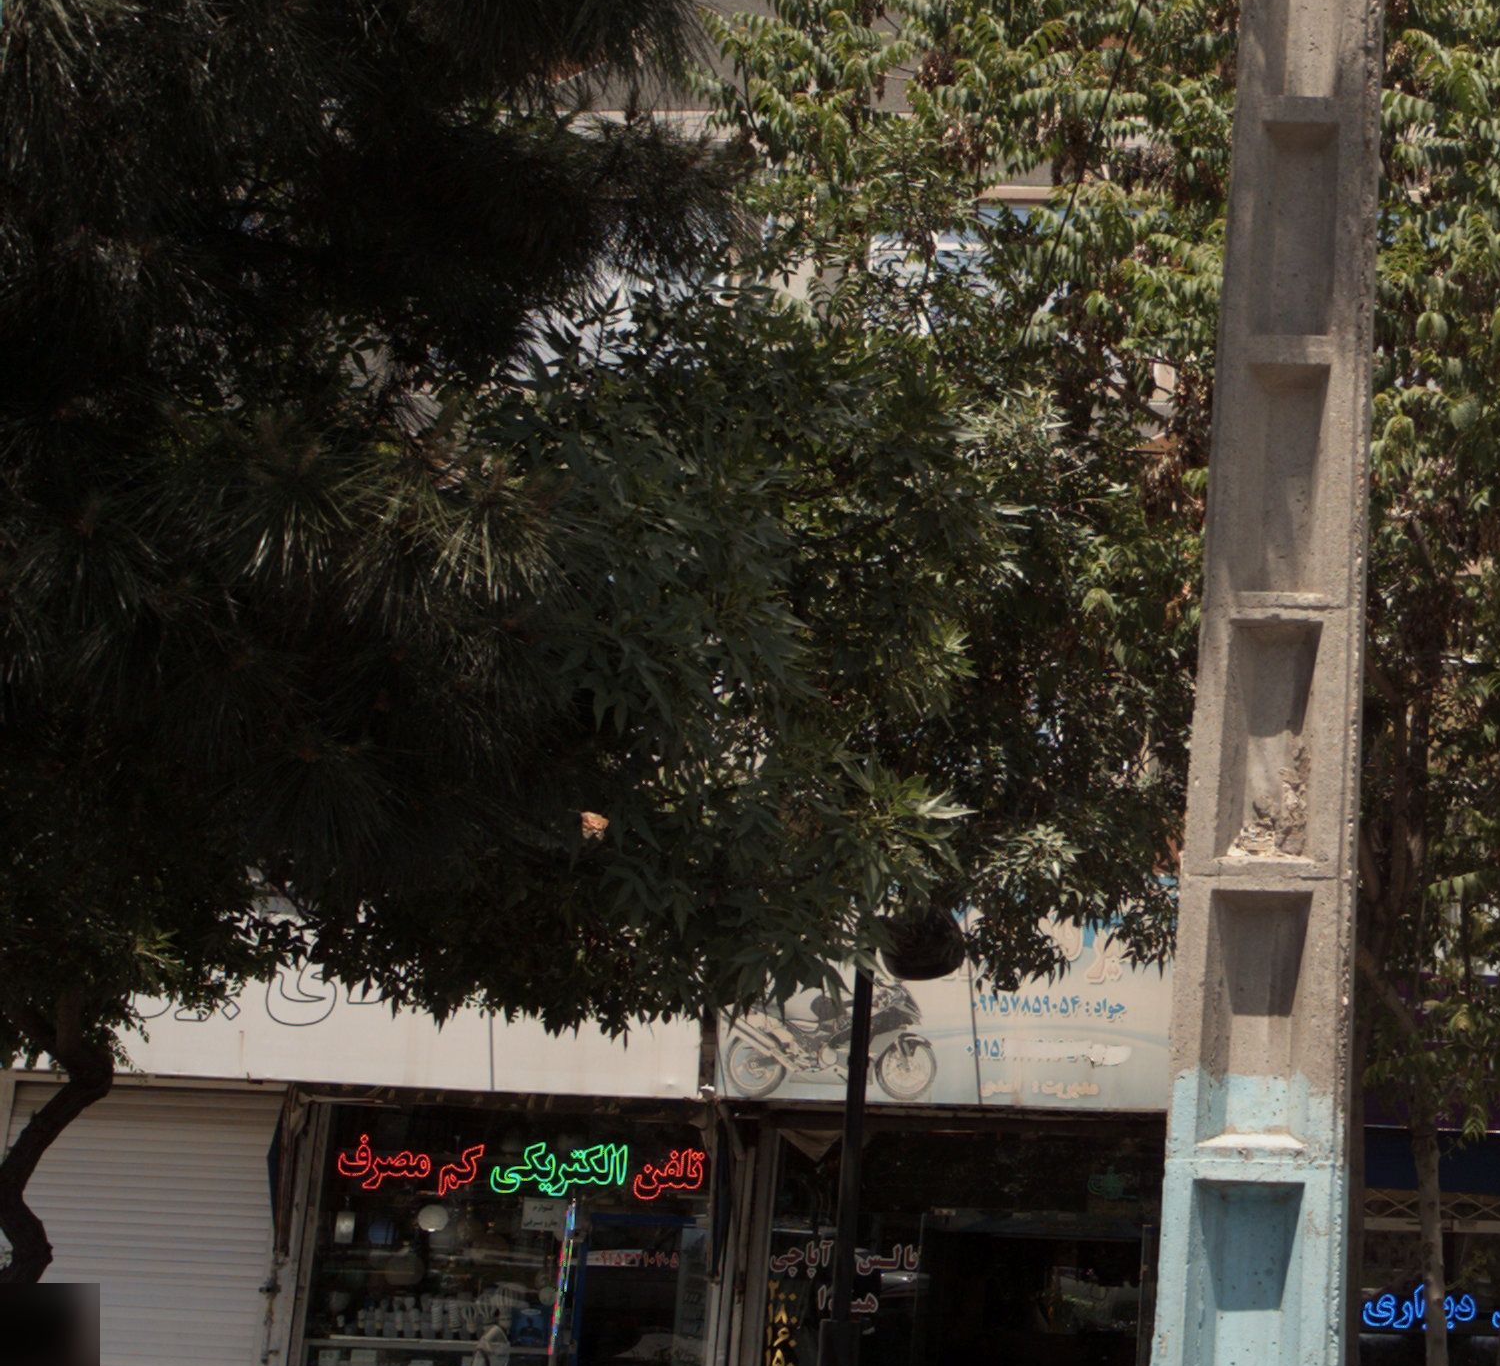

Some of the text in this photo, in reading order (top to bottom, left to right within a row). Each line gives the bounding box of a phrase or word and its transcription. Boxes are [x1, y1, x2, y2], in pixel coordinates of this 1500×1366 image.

[337, 1133, 706, 1200] تلفن الکتریکی کم مصرف
[769, 1239, 834, 1279] آپاچی
[768, 1279, 797, 1301] ۲۰۰
[768, 1302, 798, 1324] ۱۸۰
[767, 1326, 797, 1347] ۱۶۰
